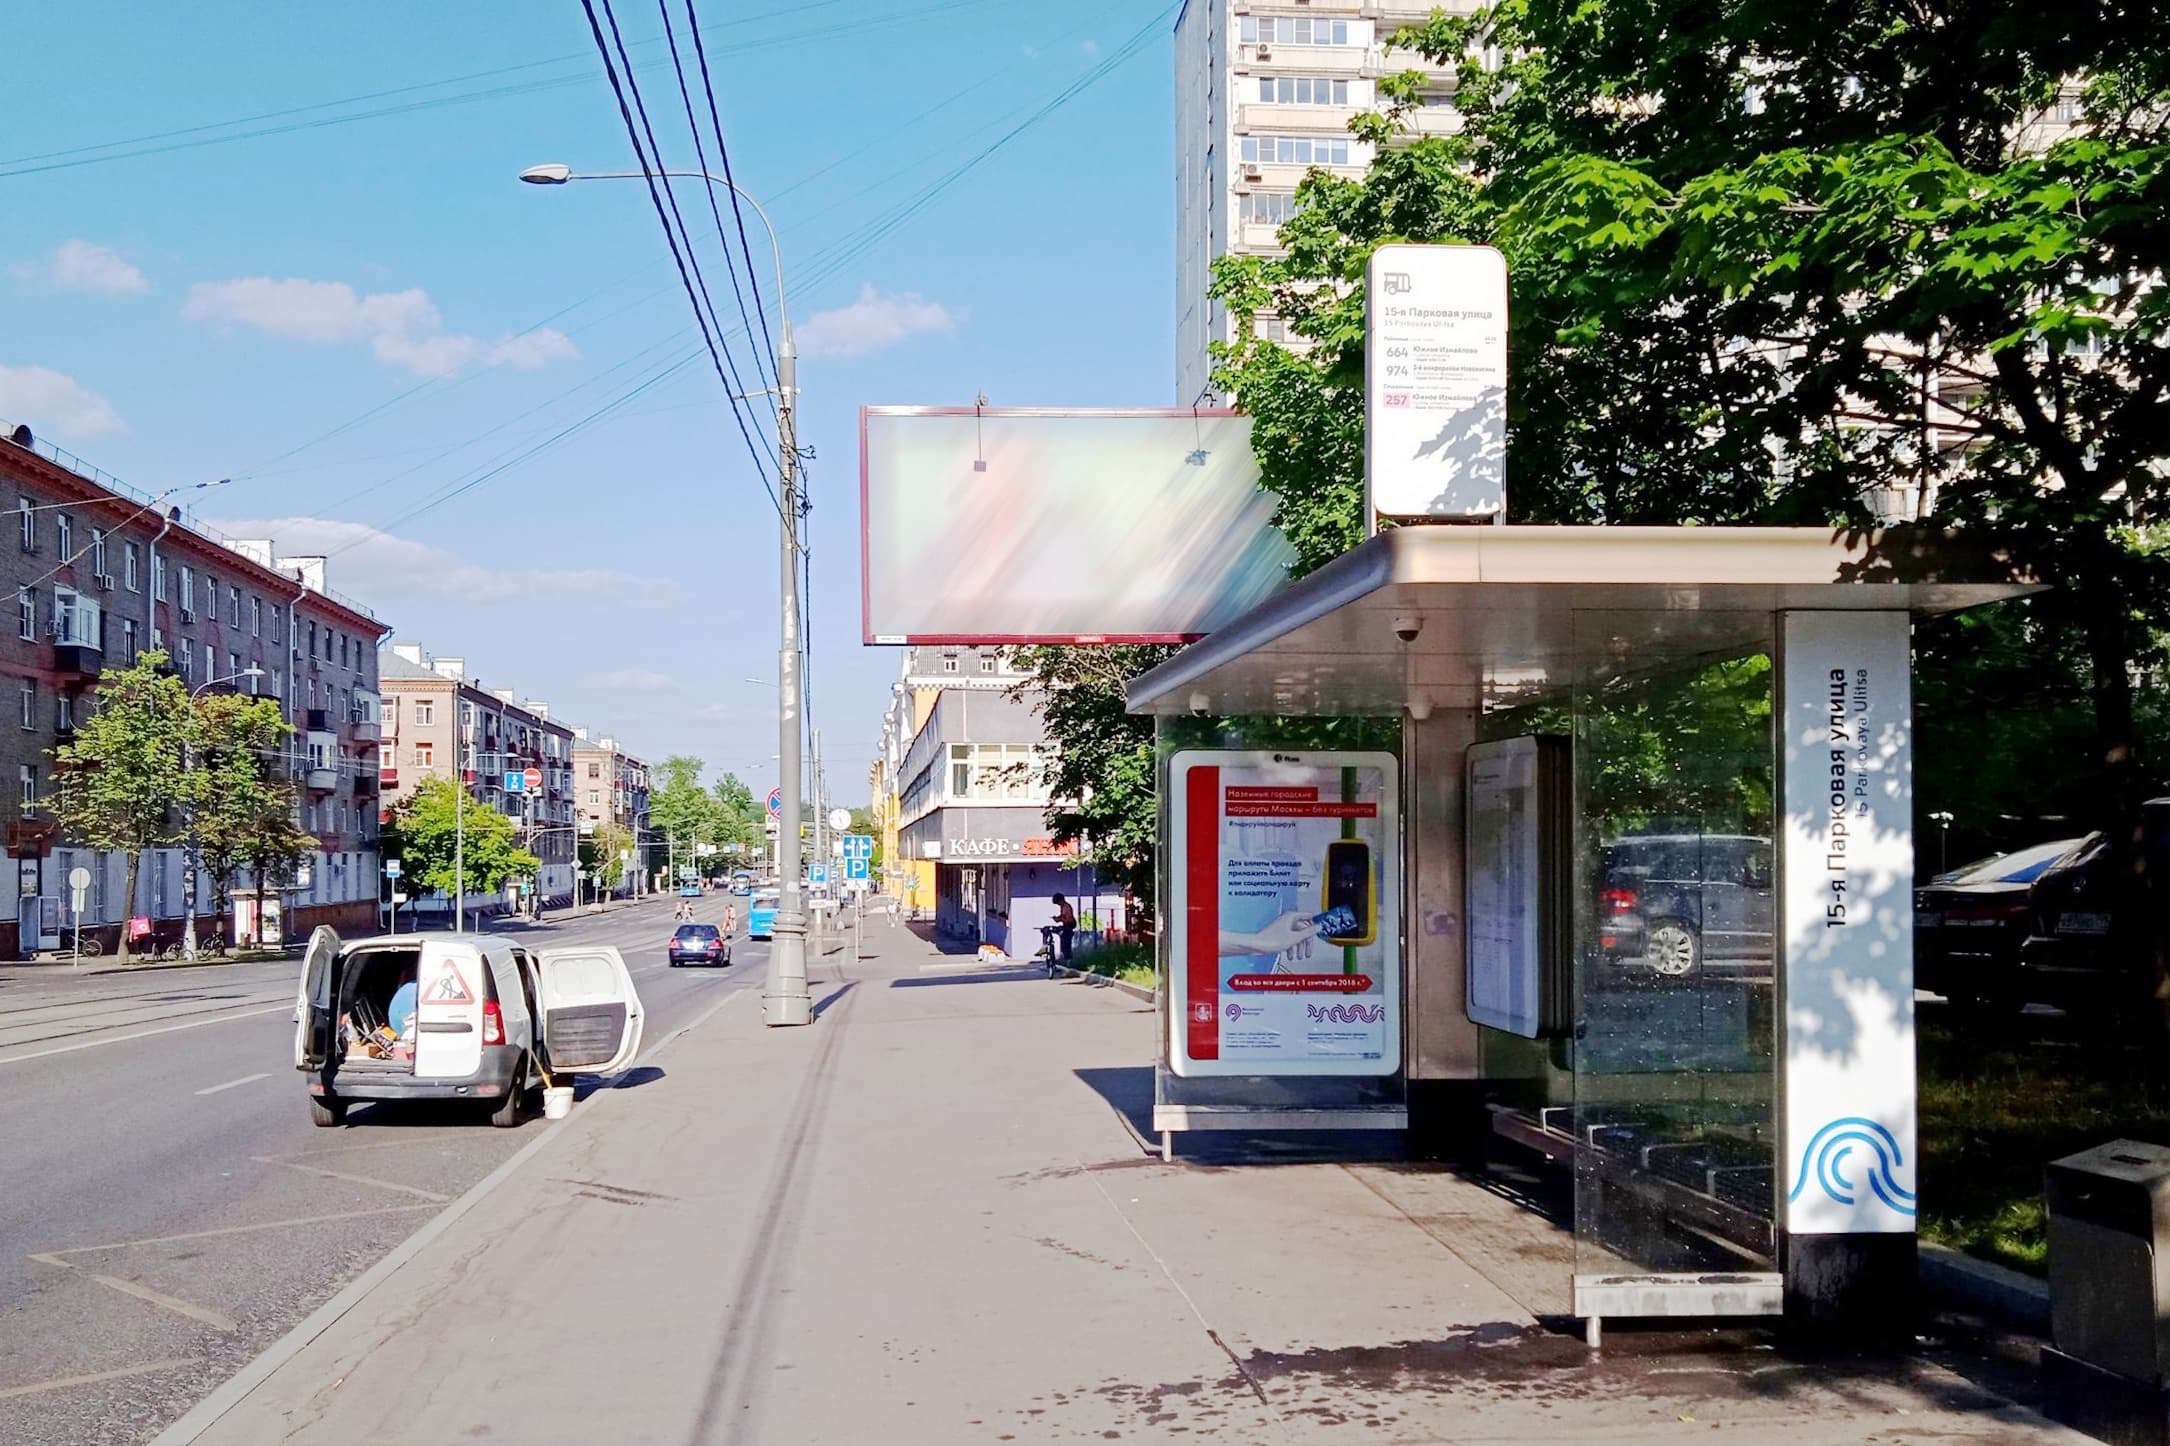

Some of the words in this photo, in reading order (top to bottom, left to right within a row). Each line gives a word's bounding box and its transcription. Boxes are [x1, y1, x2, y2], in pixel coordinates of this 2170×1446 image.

[1384, 307, 1406, 316] 15-я
[1409, 308, 1460, 318] Парковая
[1462, 310, 1492, 320] улица
[1386, 346, 1408, 358] 664
[1386, 366, 1408, 376] 974
[1386, 395, 1408, 406] 257
[1854, 668, 1868, 712] Ulitsa
[1830, 668, 1850, 742] улица
[1272, 790, 1312, 800] городские
[1228, 806, 1270, 814] маршруты
[1271, 805, 1303, 813] Москвы
[1827, 750, 1850, 871] Парковая
[950, 838, 1010, 856] КАФЕ
[1228, 860, 1242, 868] Для
[1244, 880, 1286, 889] социальную
[1287, 880, 1310, 888] карту
[1827, 880, 1846, 928] 15-я
